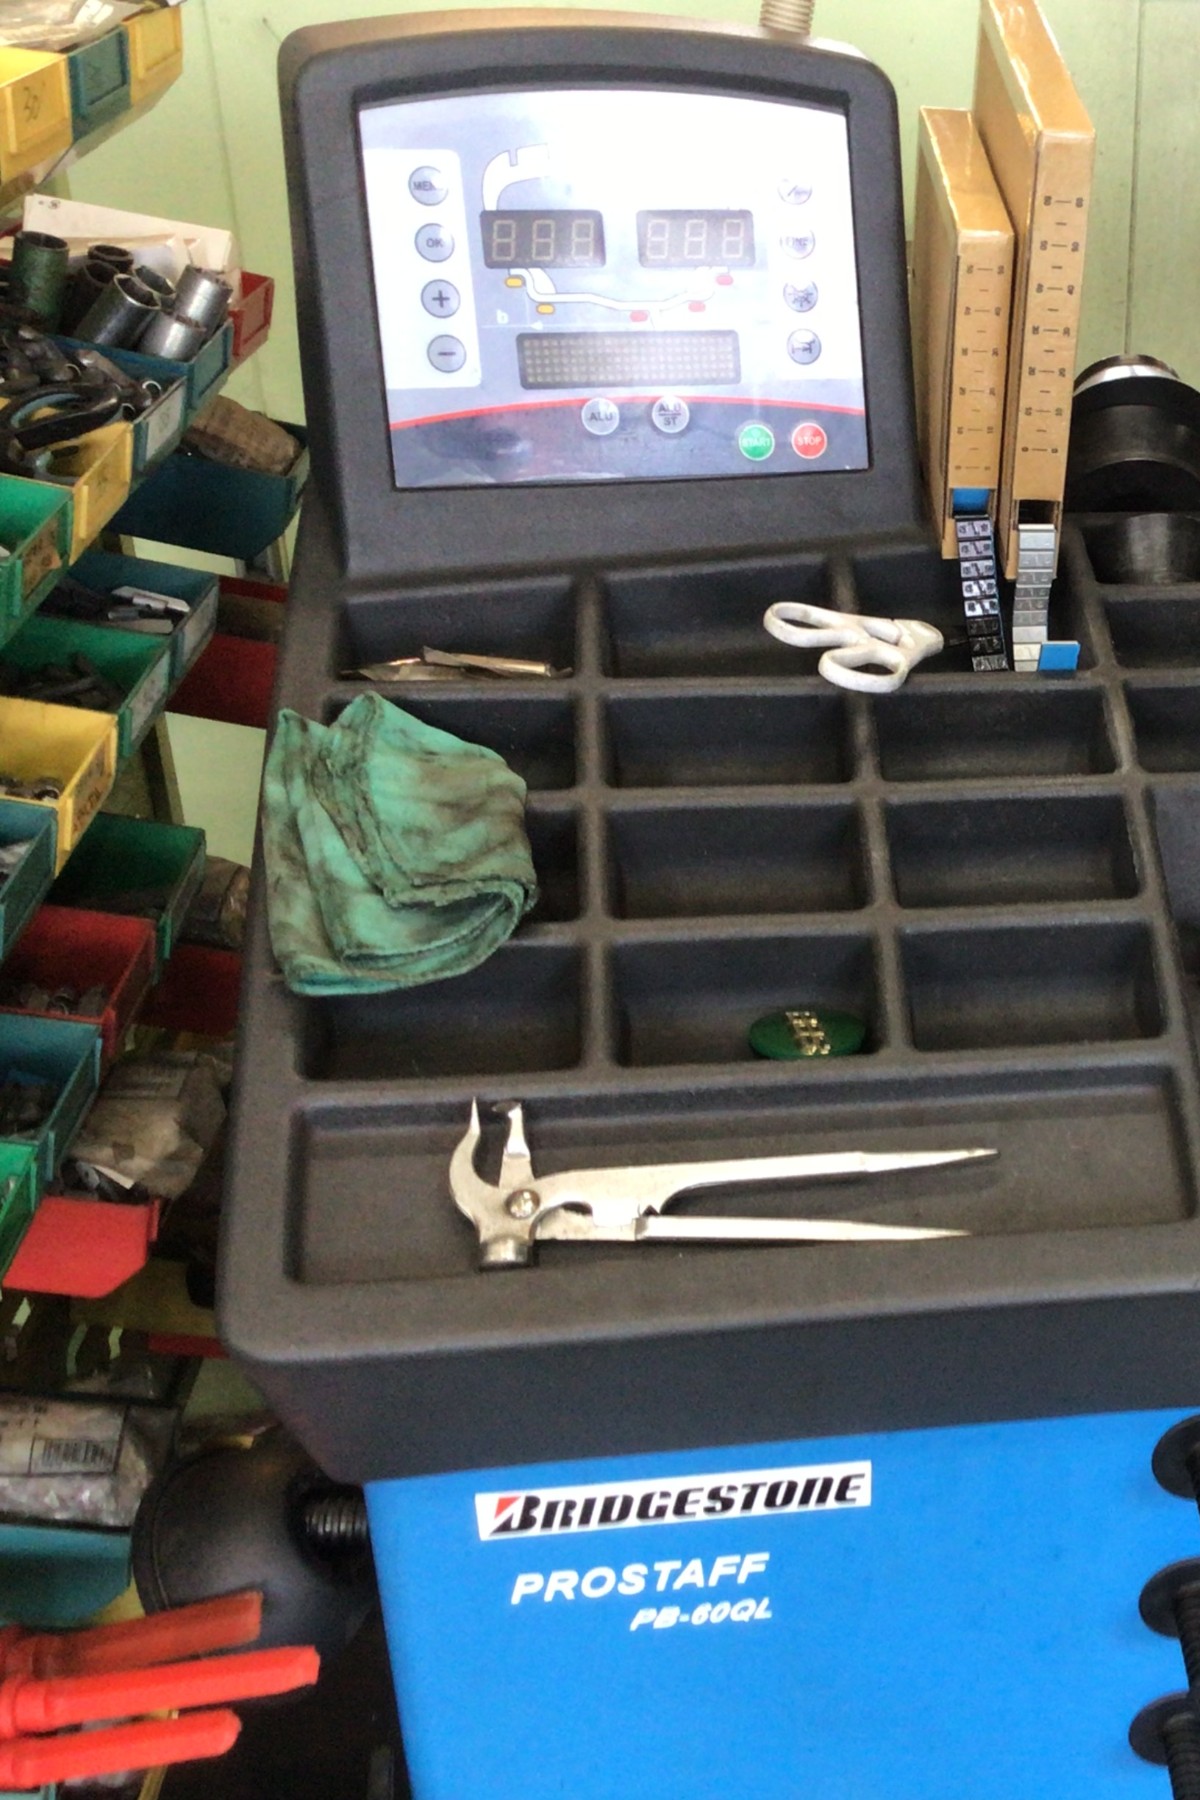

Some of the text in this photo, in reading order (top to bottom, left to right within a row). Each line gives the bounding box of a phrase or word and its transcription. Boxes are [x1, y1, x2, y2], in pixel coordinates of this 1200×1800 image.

[425, 238, 444, 249] OK
[657, 403, 682, 414] ALU
[588, 411, 613, 422] ALU
[664, 416, 678, 426] ST
[741, 437, 772, 448] START
[797, 436, 822, 447] STOP
[487, 1472, 867, 1537] BRIDGESTONE
[511, 1551, 771, 1605] PROSTAFF
[629, 1597, 773, 1632] PB-60QL
